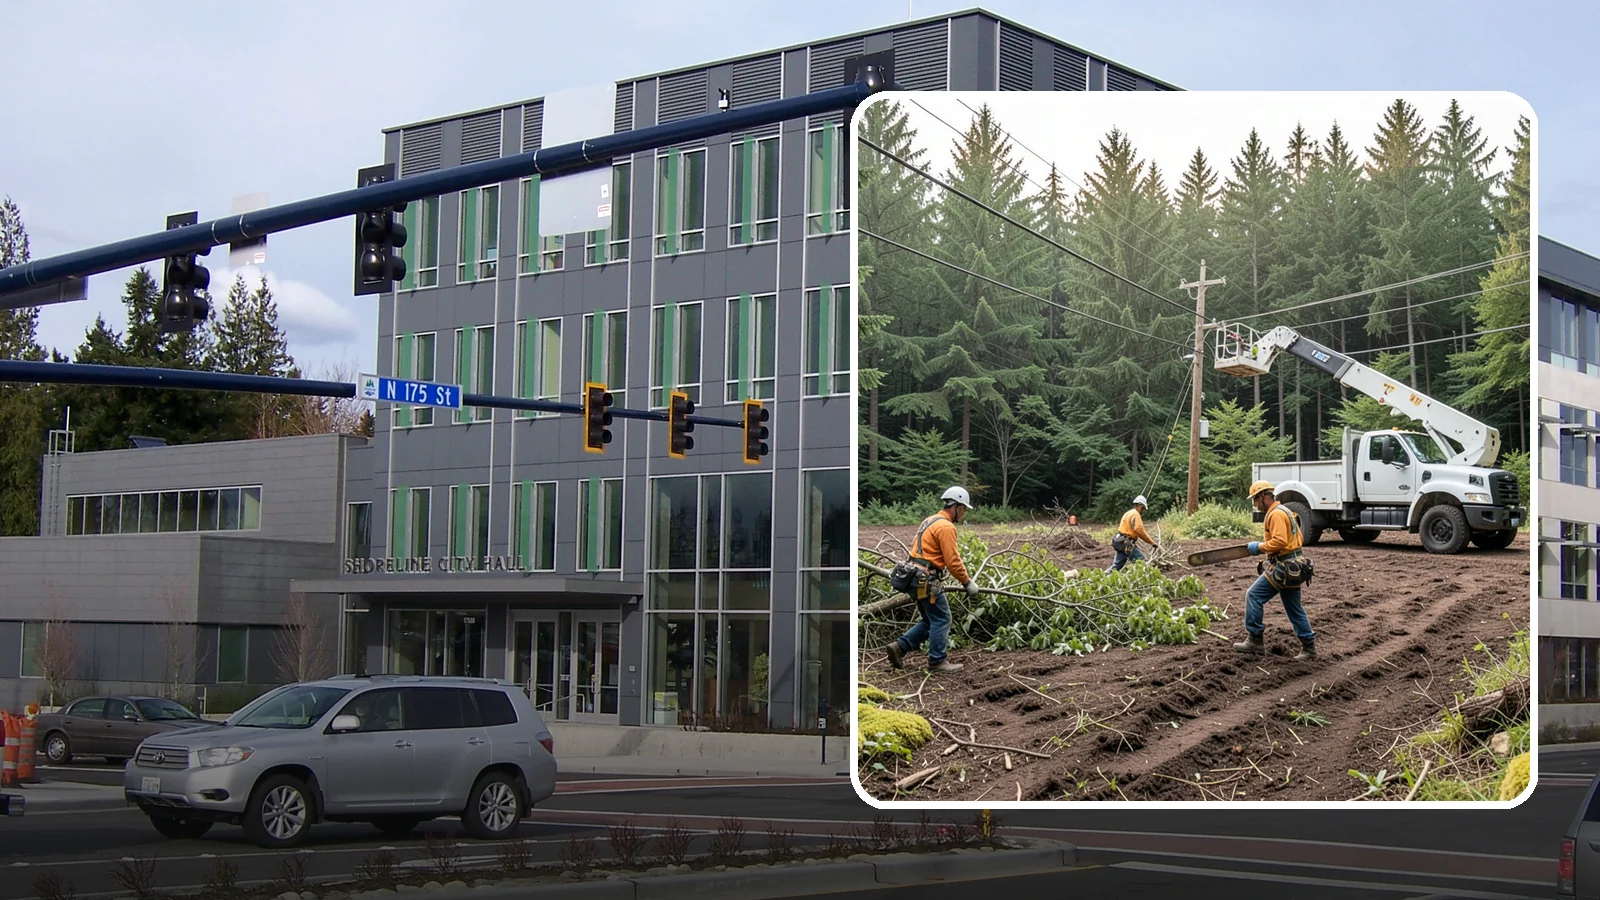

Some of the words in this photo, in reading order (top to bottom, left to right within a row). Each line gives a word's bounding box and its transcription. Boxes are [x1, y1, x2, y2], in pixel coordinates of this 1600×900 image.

[387, 380, 396, 399] N
[405, 383, 427, 403] 175
[436, 386, 452, 406] St
[345, 557, 432, 574] SHORELINE
[438, 557, 475, 572] CITY
[483, 556, 525, 571] HALL
